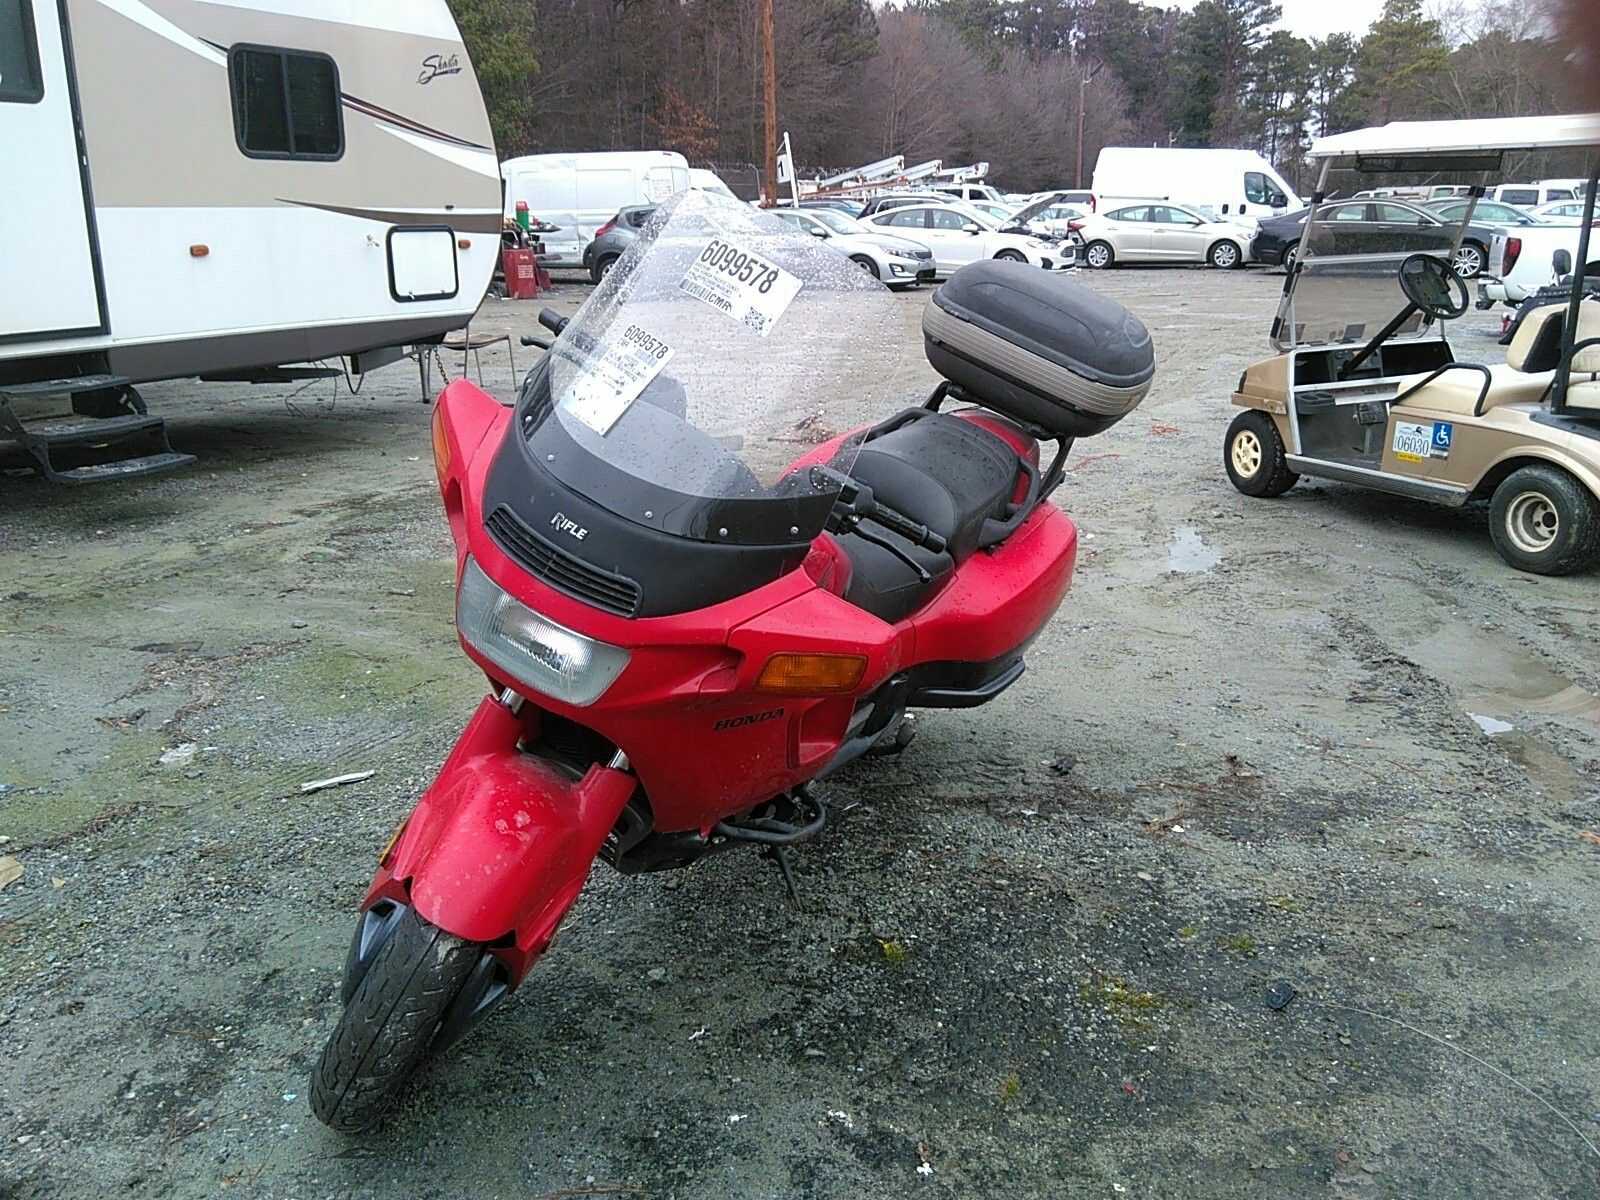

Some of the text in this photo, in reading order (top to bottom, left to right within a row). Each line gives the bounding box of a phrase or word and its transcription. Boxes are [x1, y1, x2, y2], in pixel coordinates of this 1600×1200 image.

[778, 161, 784, 177] 1
[701, 240, 778, 294] 6099578
[624, 324, 669, 360] 6099578
[551, 512, 588, 540] RIFLE
[713, 706, 785, 731] HONDA
